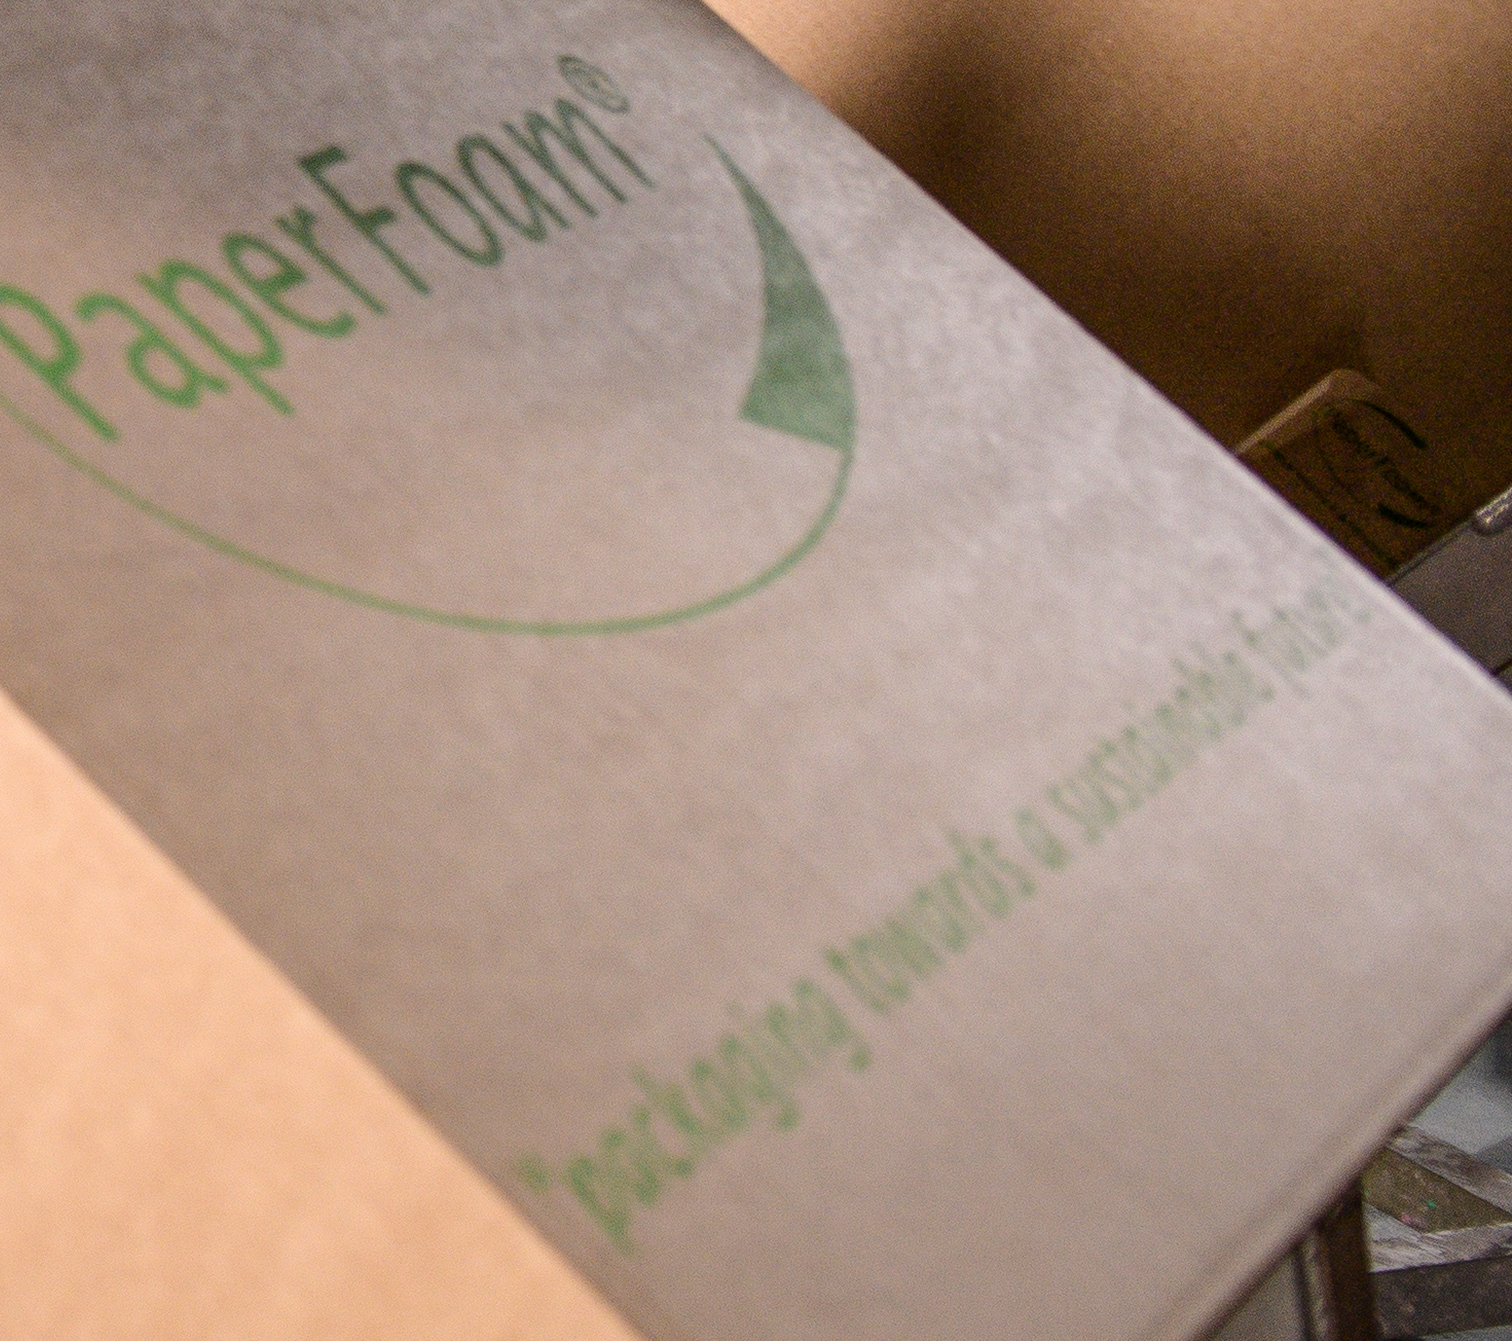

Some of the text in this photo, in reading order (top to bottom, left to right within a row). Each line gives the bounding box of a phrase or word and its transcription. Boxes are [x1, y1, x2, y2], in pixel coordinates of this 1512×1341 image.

[821, 829, 1039, 1016] towards
[1014, 804, 1070, 874] a
[1045, 641, 1278, 846] sustainable
